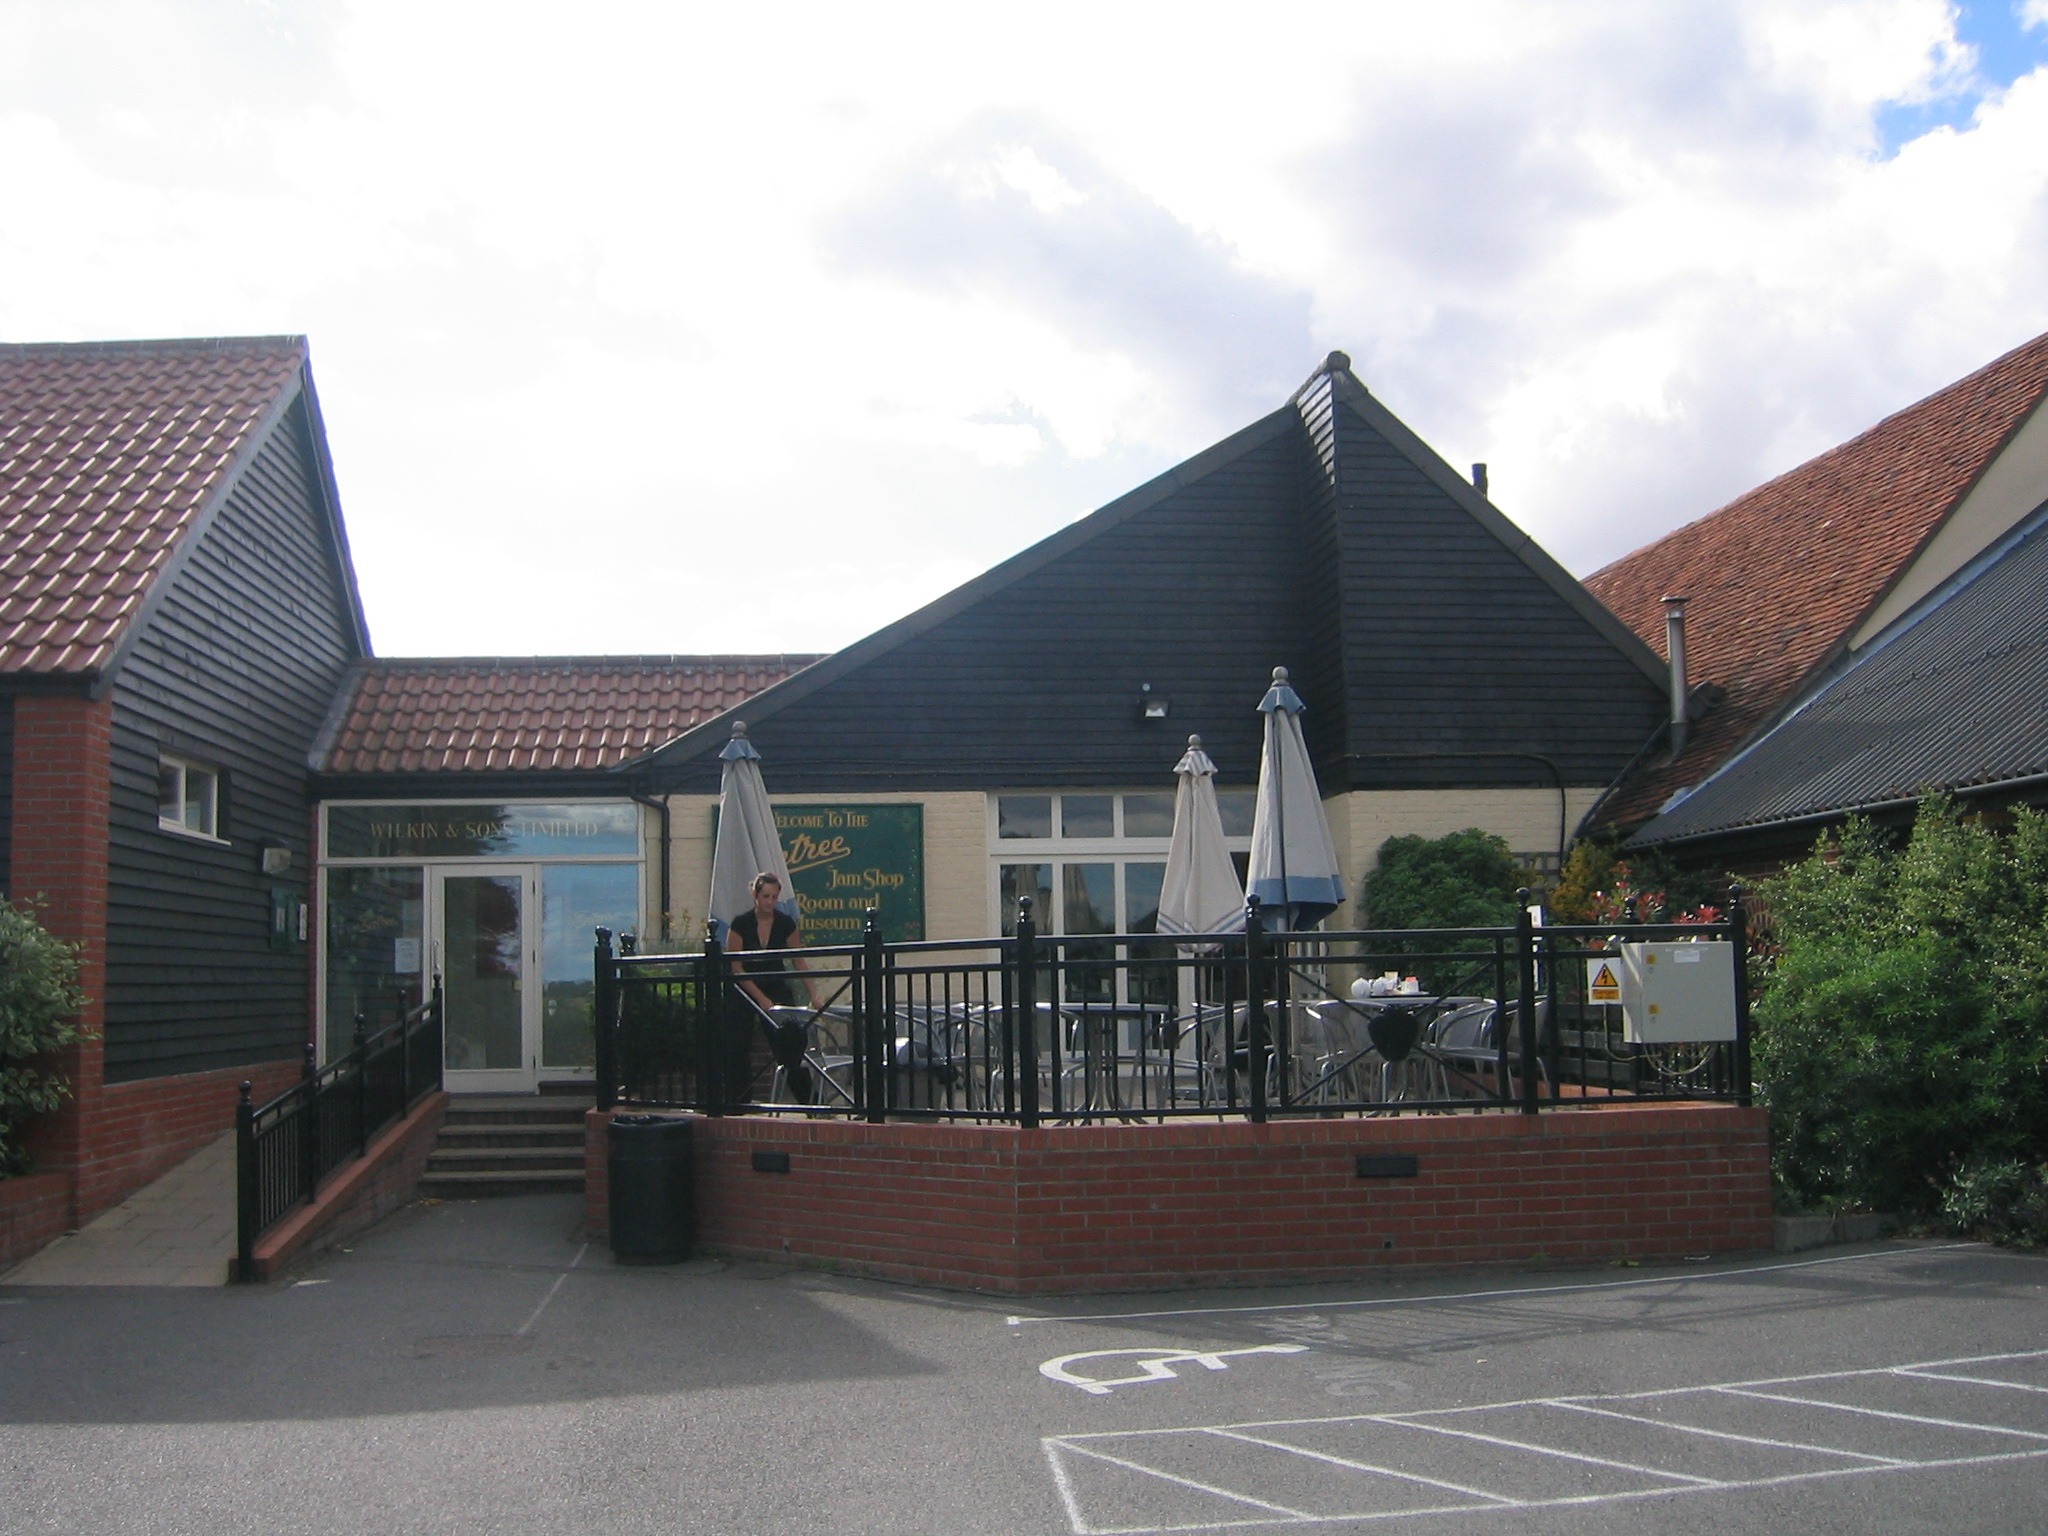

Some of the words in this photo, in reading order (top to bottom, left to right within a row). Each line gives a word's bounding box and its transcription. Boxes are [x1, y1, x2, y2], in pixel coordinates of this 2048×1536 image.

[370, 822, 438, 838] WILKIN
[445, 822, 458, 838] &
[464, 821, 513, 838] SONS
[521, 821, 598, 838] LIMITED
[827, 866, 860, 889] Jam
[863, 869, 903, 889] Shop
[797, 893, 843, 913] Room
[849, 893, 880, 909] and
